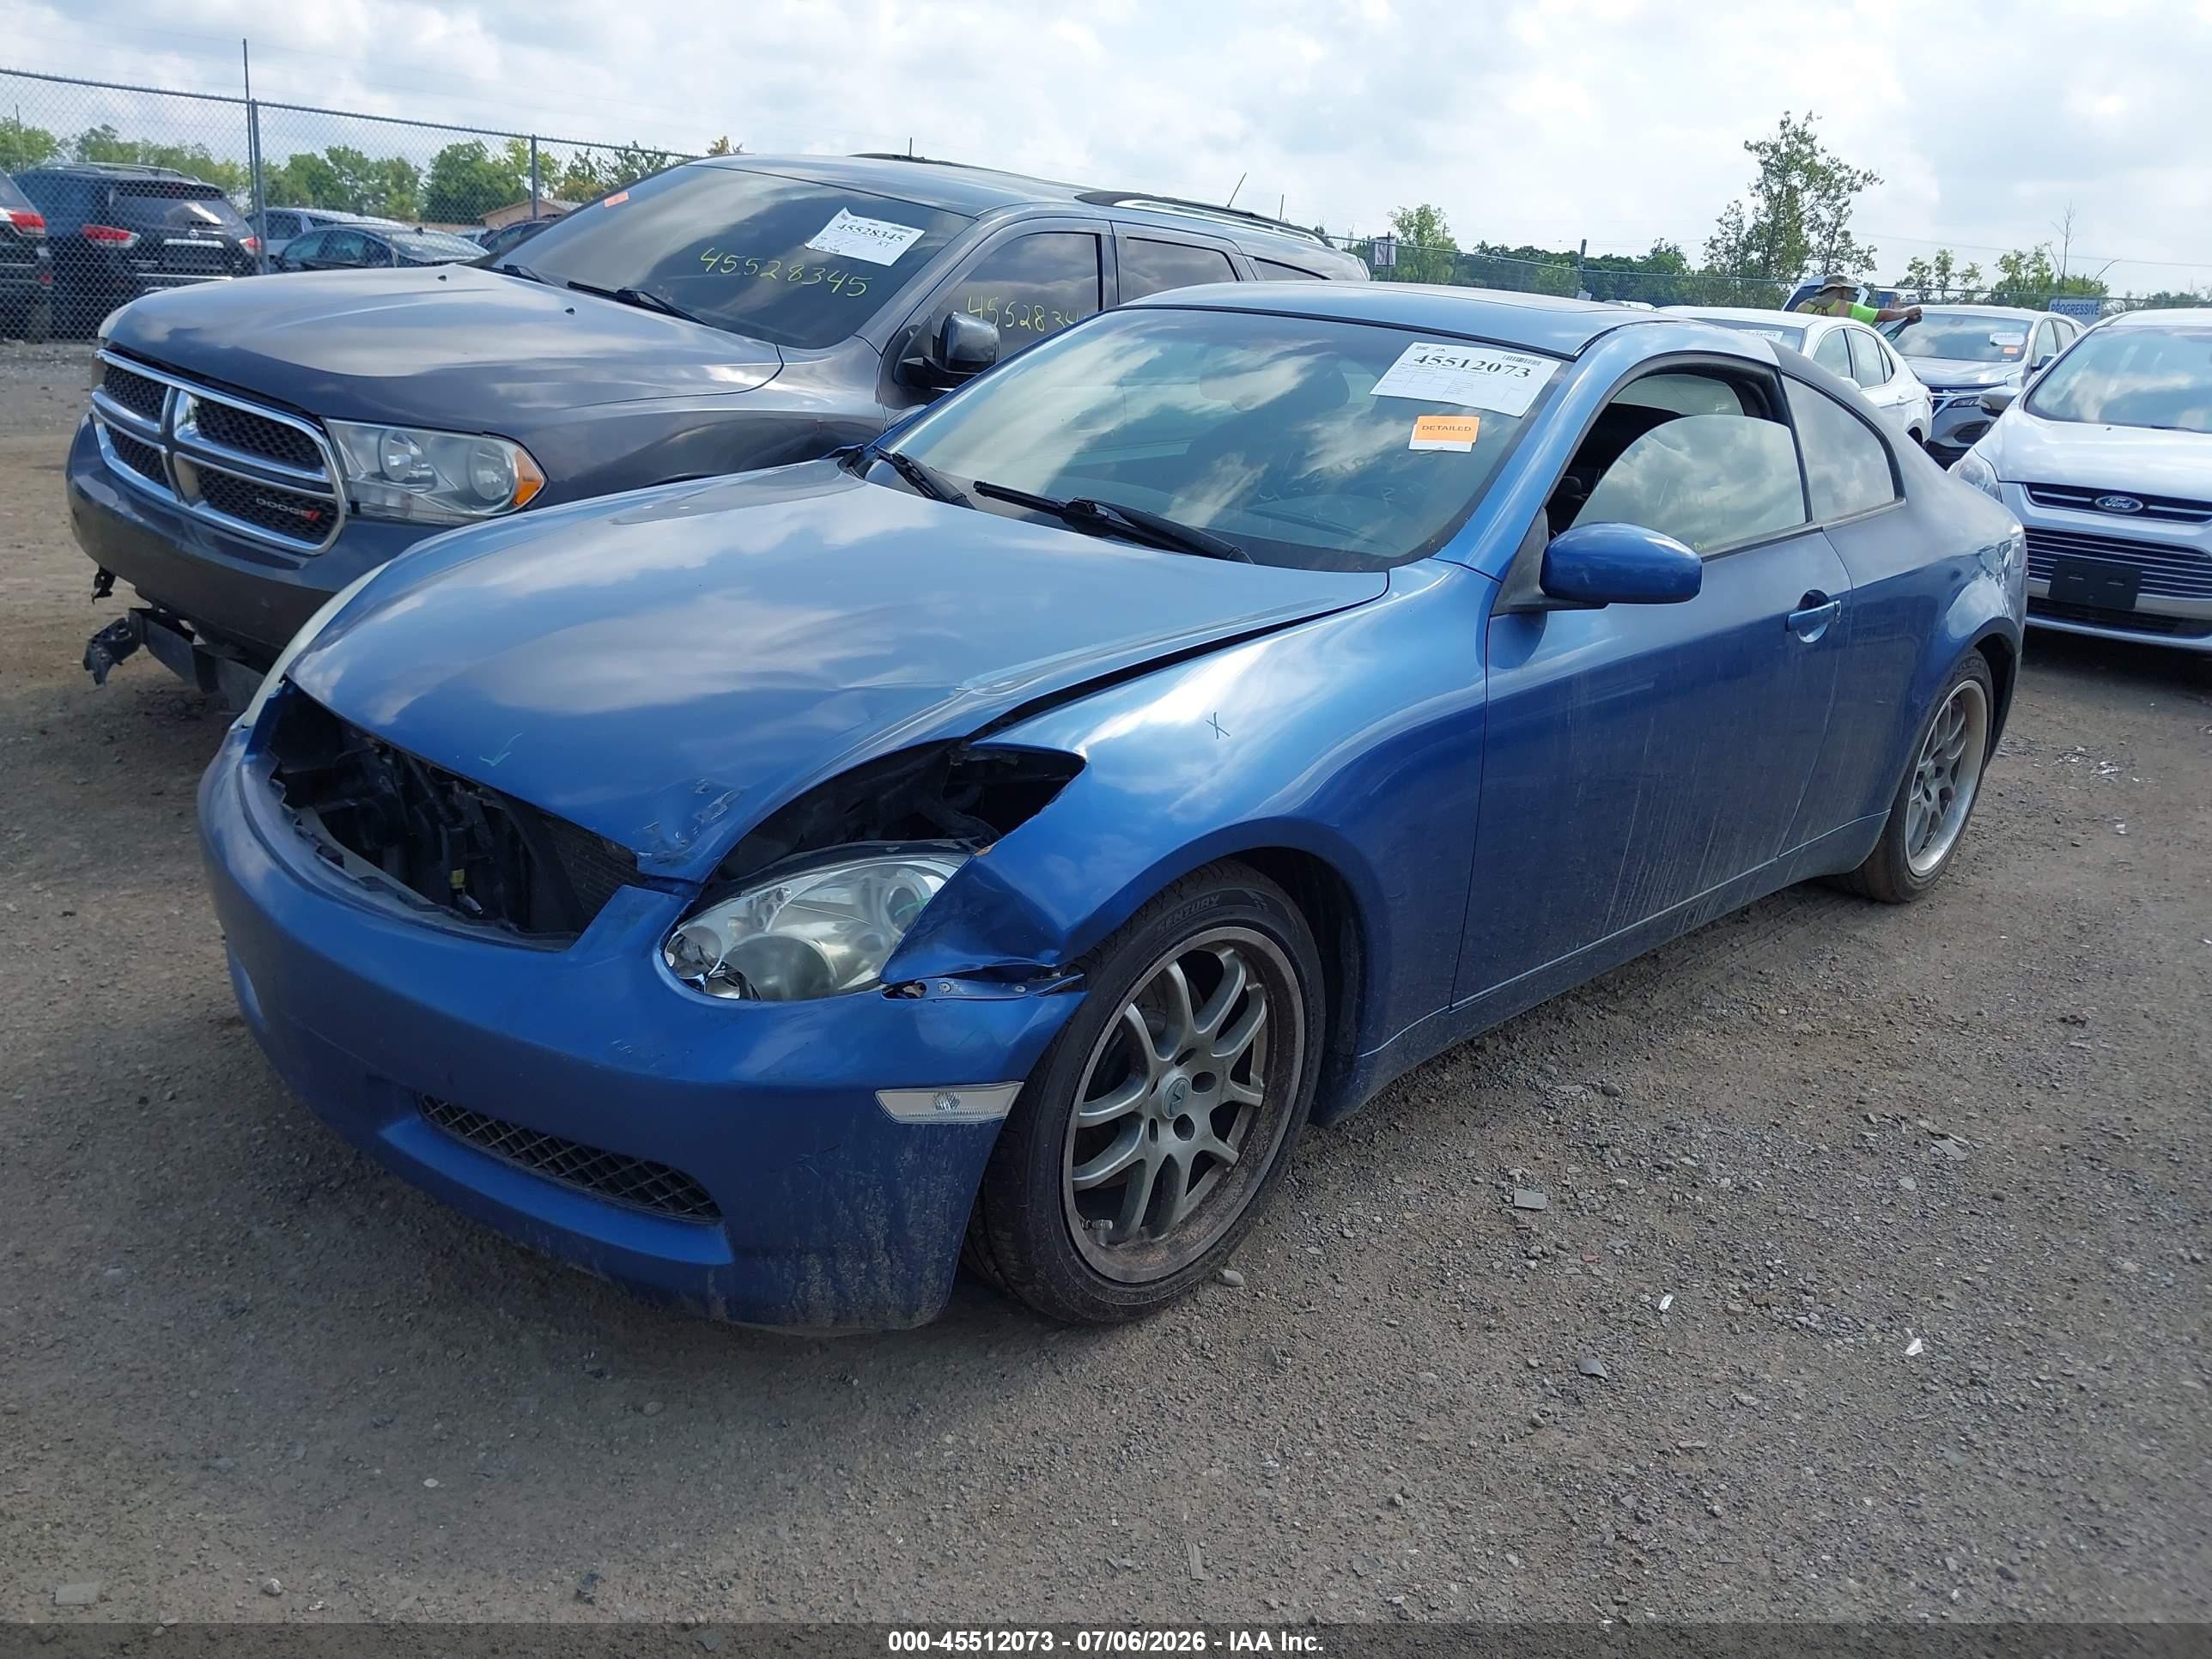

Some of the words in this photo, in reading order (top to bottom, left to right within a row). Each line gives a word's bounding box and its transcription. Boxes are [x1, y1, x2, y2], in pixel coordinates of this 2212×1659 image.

[837, 223, 907, 242] 45528345
[700, 247, 872, 297] 45528345
[968, 295, 1088, 332] 4552834
[2051, 303, 2100, 315] PROGRESSIVE
[1413, 355, 1531, 378] 45512073
[256, 497, 311, 518] DODGE
[2105, 497, 2134, 508] Ford
